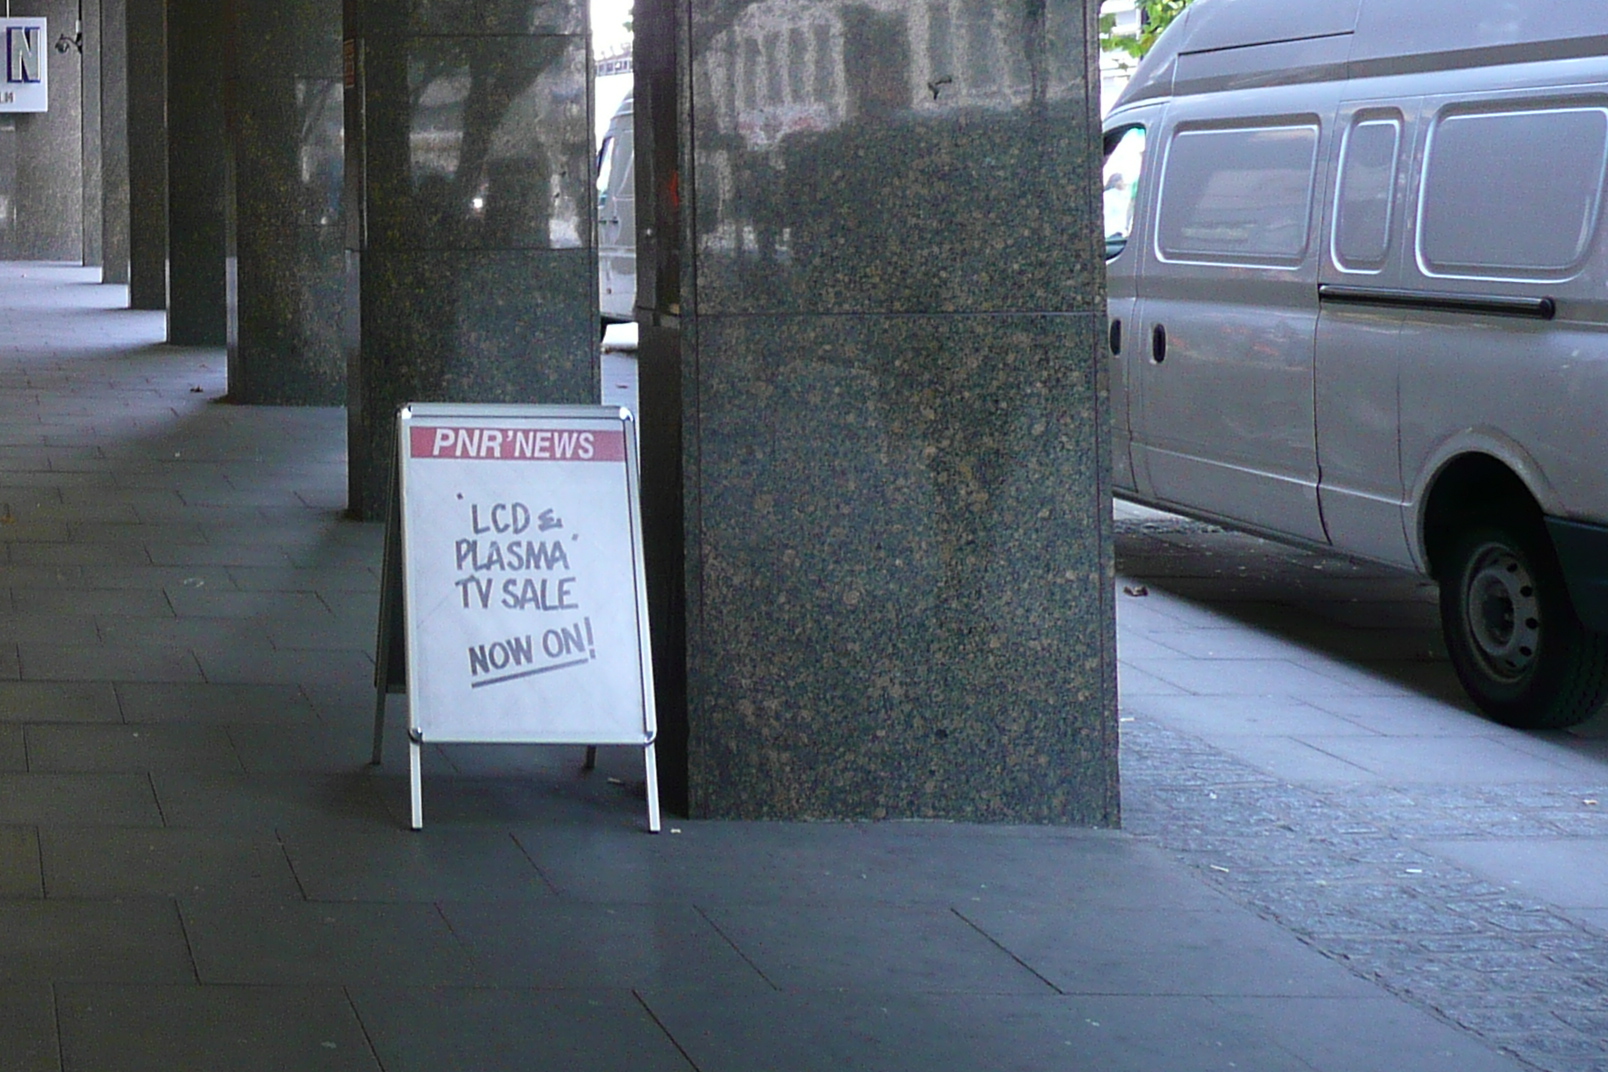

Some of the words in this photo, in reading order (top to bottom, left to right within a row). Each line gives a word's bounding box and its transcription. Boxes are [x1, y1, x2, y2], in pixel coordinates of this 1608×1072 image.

[471, 502, 531, 535] LCD
[537, 508, 563, 532] &
[455, 538, 570, 572] PLASMA
[454, 575, 493, 609] TV
[501, 576, 579, 611] SALE
[468, 634, 533, 676] NOW
[542, 616, 596, 660] ON!
